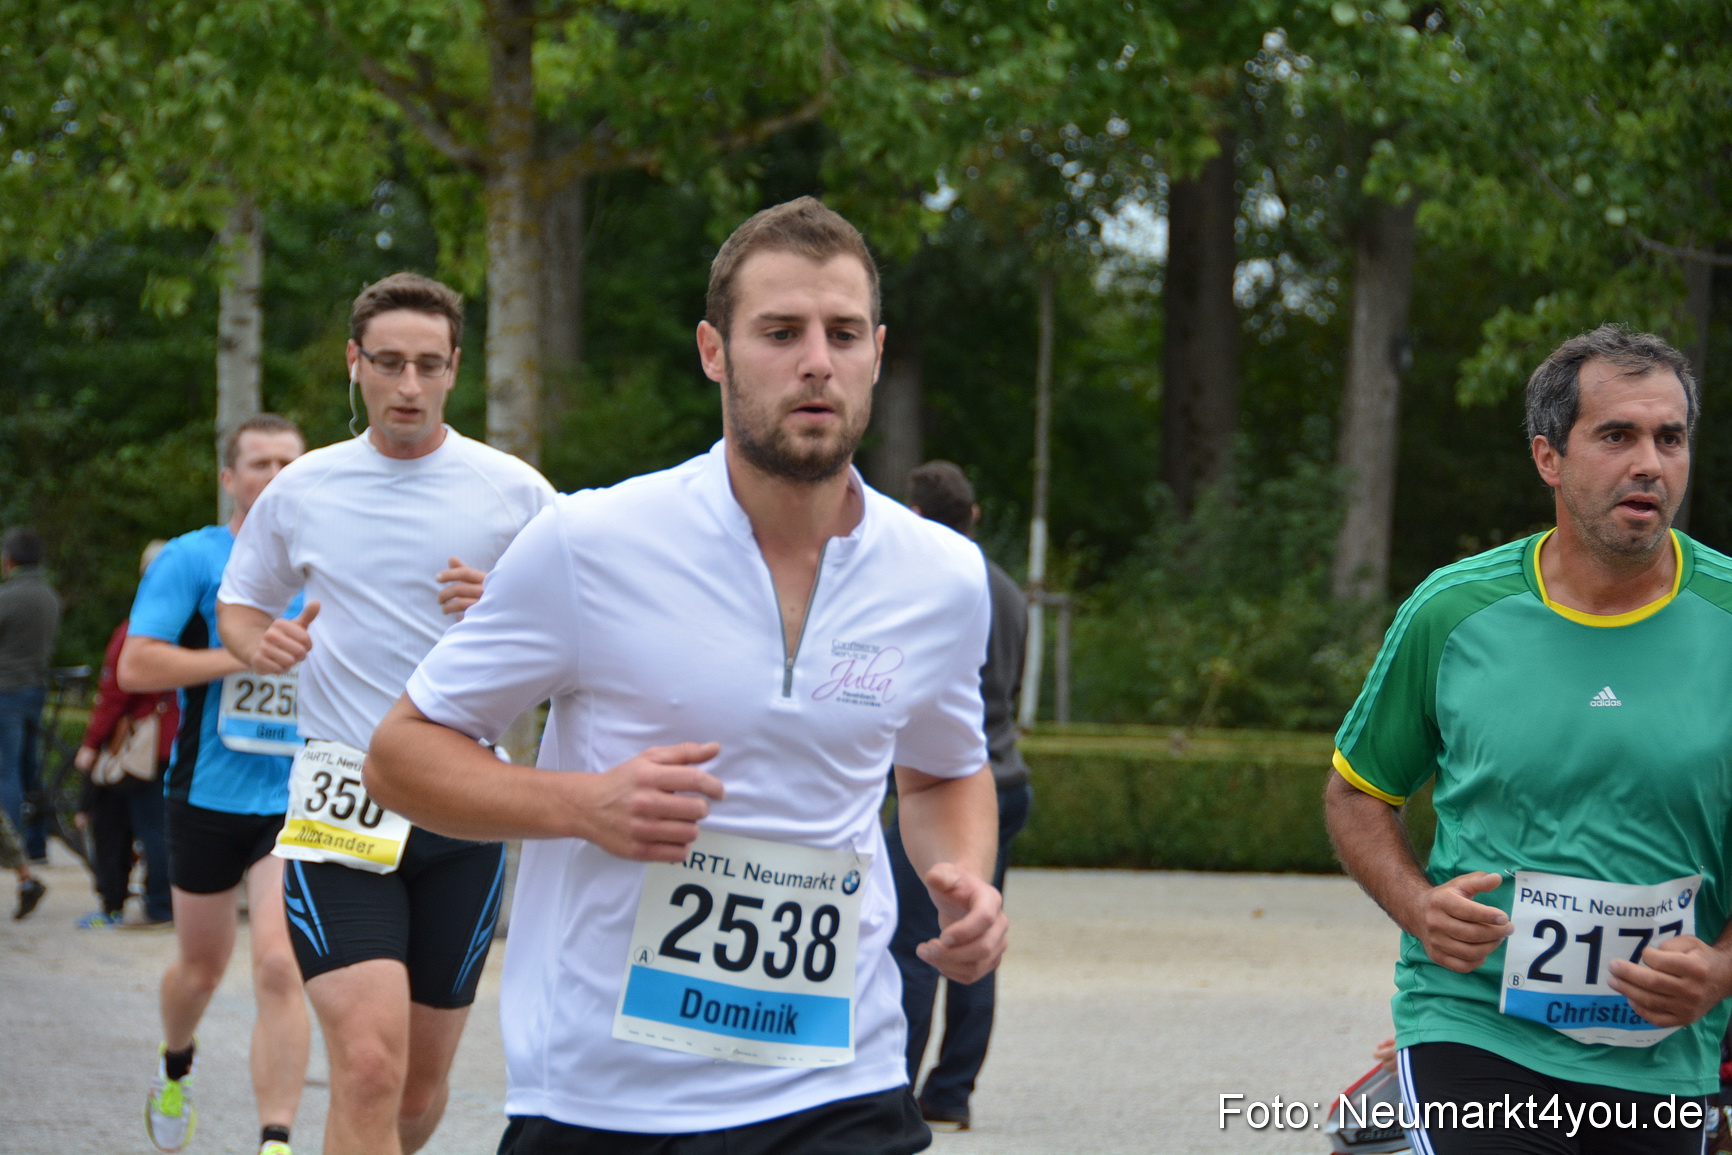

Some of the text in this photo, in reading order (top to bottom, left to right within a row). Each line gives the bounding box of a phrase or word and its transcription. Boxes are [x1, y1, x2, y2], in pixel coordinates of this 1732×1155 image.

[811, 645, 904, 704] Julia
[234, 679, 298, 719] 225
[1590, 698, 1622, 707] adidas
[302, 751, 363, 772] PARTL Neu
[294, 826, 375, 855] Alexander
[671, 851, 837, 890] RTL Neumarkt
[1520, 887, 1674, 918] PARTL Neumarkt
[658, 883, 841, 983] 2538
[1512, 974, 1520, 986] B
[679, 987, 800, 1036] Dominik
[1546, 1001, 1650, 1025] Christia
